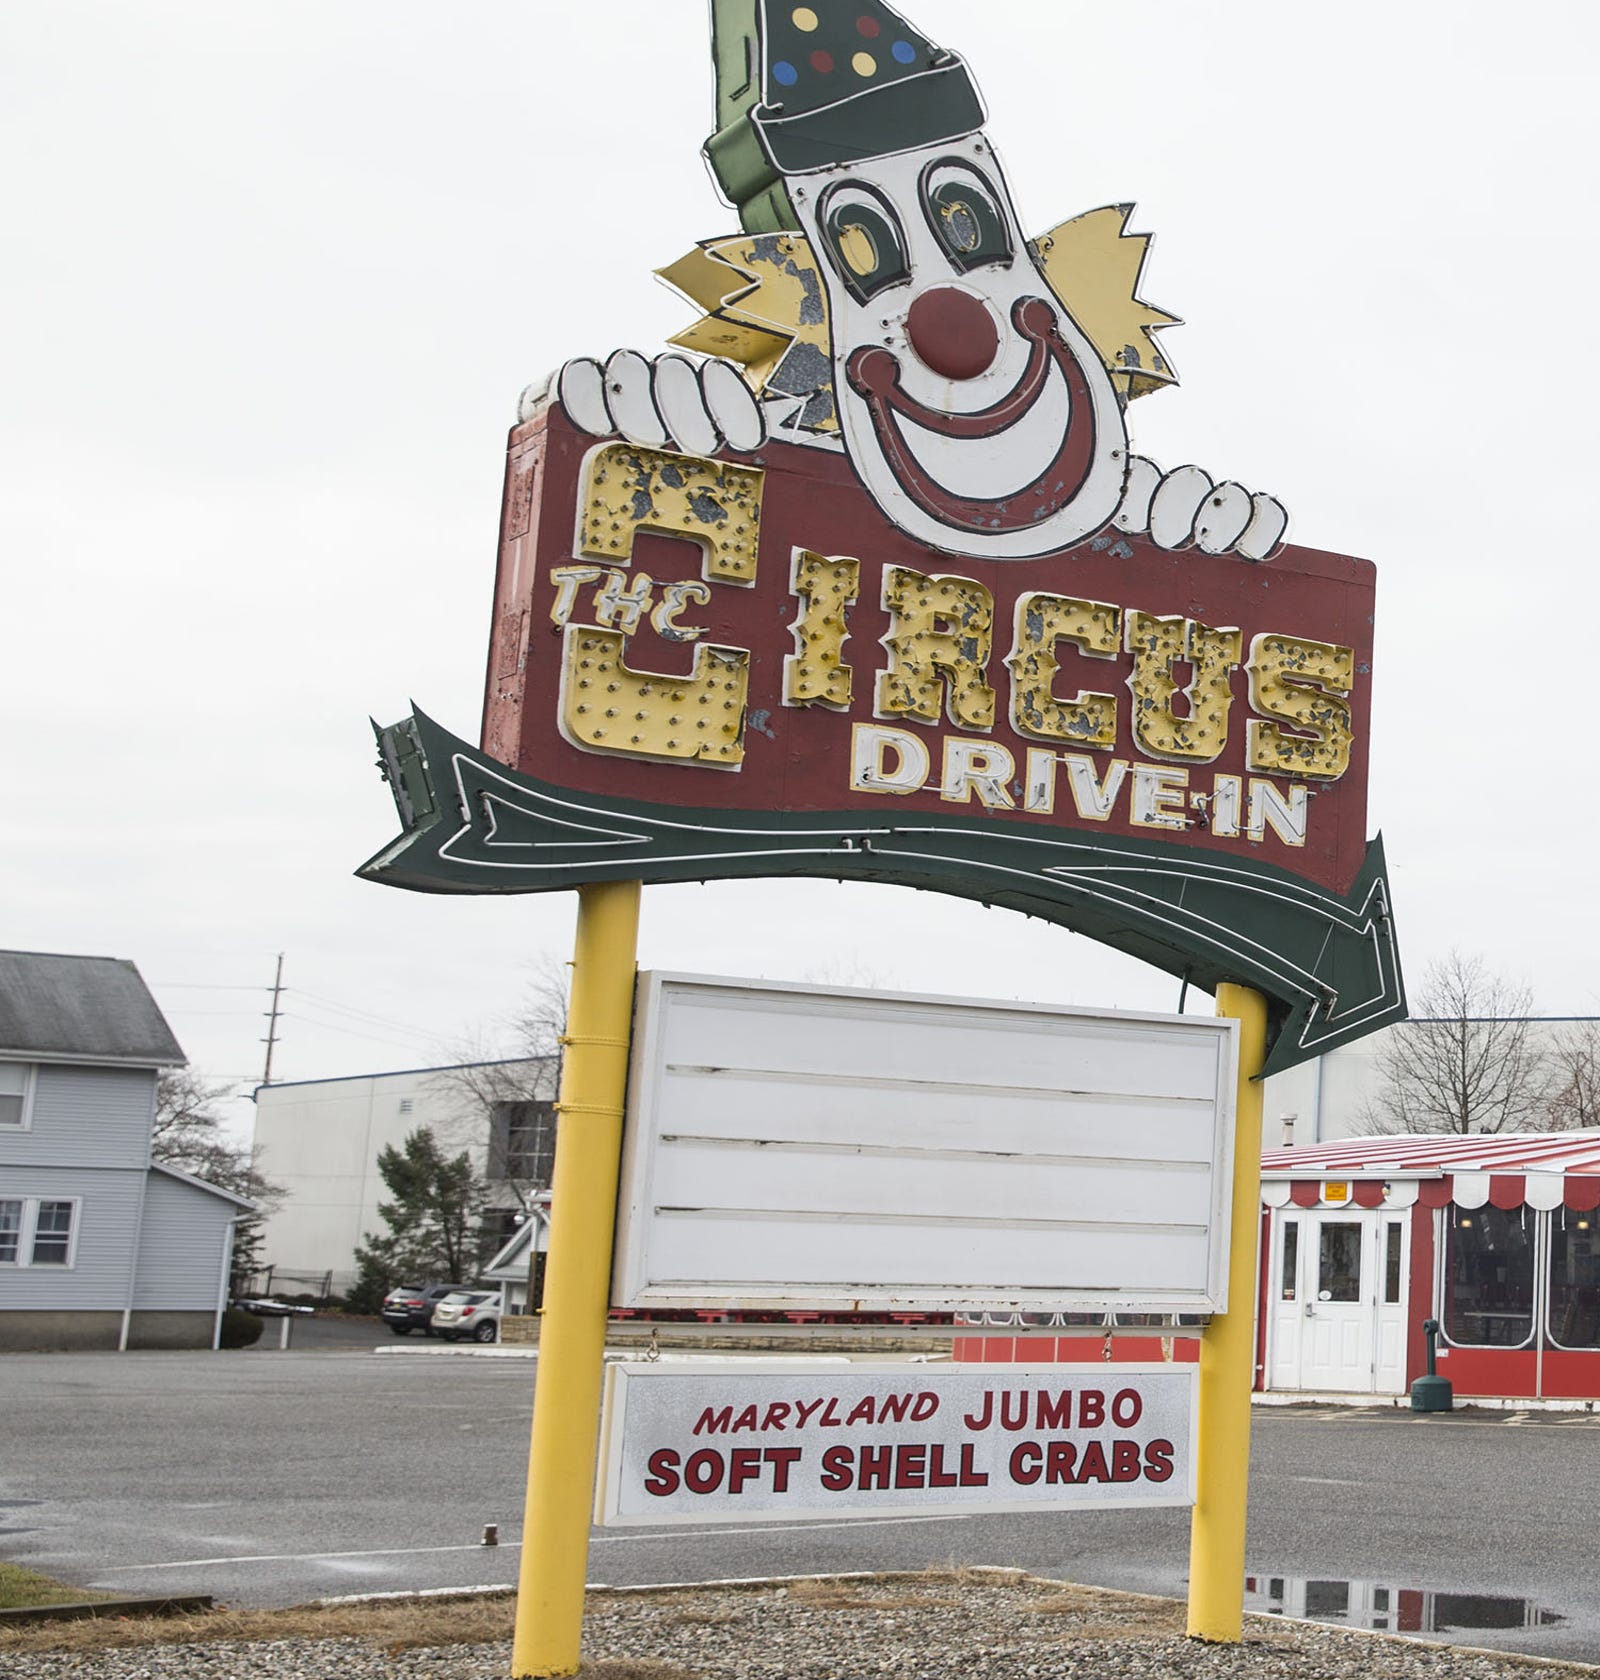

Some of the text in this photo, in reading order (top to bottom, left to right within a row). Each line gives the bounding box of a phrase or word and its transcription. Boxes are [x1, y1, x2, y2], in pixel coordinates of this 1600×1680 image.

[550, 565, 711, 642] THE
[557, 440, 1357, 781] CIRCUS
[850, 722, 1315, 848] DRIVE-IN
[692, 1388, 1144, 1436] MARYLAND JUMBO
[644, 1438, 1175, 1497] SOFT SHELL CRABS
